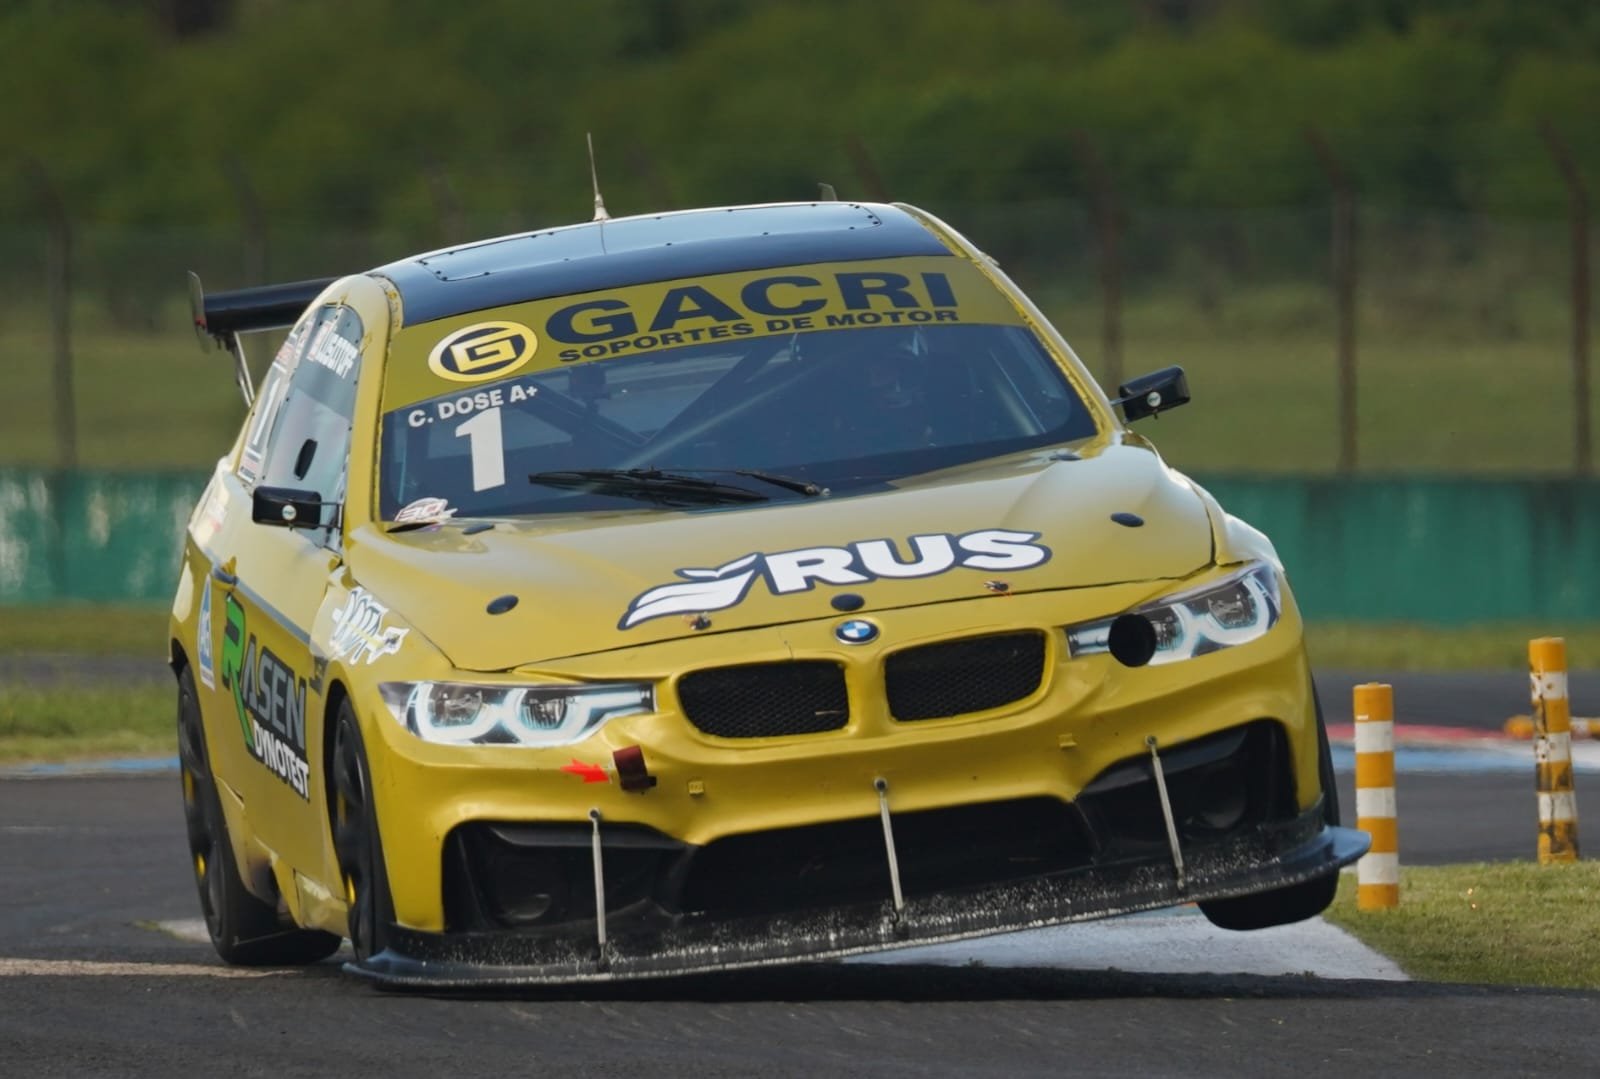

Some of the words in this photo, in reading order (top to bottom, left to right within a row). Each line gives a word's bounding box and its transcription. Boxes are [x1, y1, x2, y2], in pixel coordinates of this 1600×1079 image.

[545, 272, 958, 344] GACRI
[558, 322, 754, 362] SOPORTES
[766, 316, 814, 333] DE
[826, 309, 960, 326] MOTOR
[408, 409, 434, 427] C.
[438, 389, 504, 420] DOSE
[510, 384, 538, 403] A+
[455, 406, 505, 492] 1
[764, 528, 1049, 594] RUS
[222, 592, 307, 751] RASEN
[252, 719, 310, 800] DYNOTEST
